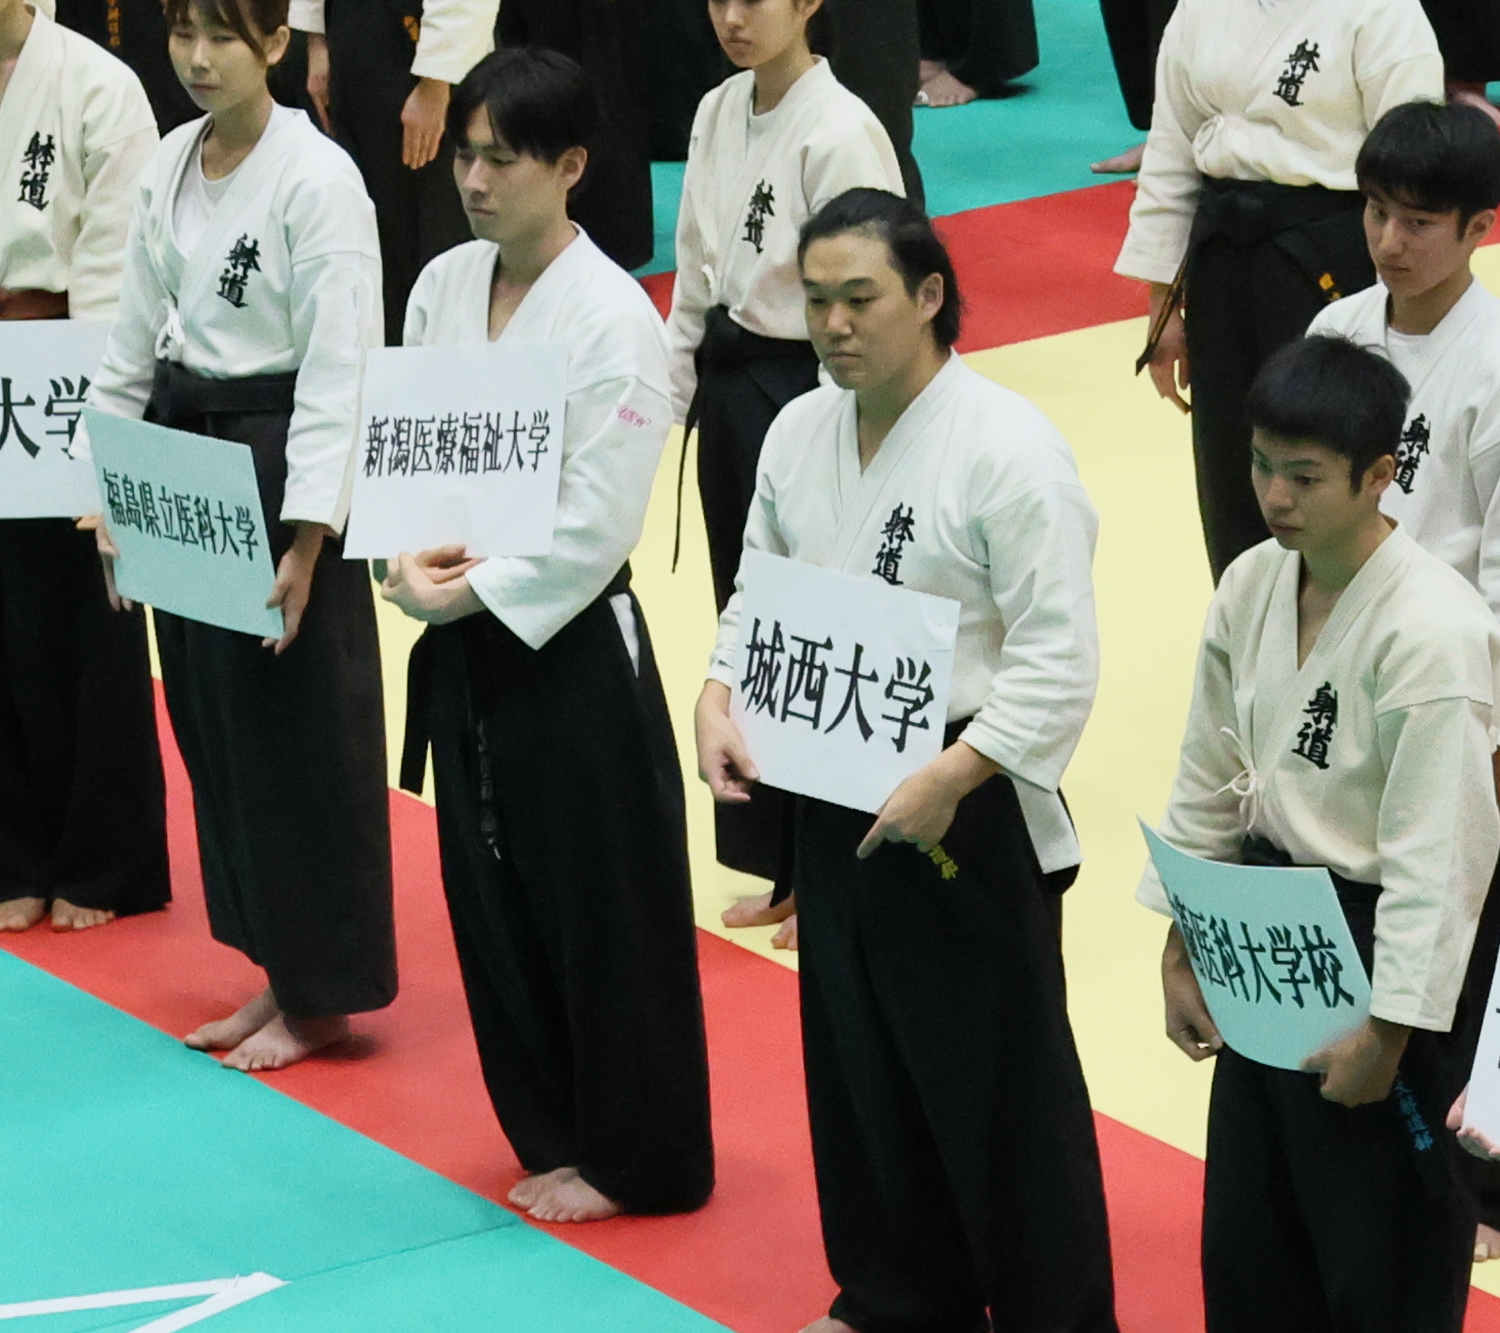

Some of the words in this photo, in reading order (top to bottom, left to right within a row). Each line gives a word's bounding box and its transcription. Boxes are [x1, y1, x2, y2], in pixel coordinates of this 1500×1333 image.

[364, 409, 551, 478] 新潟医療福祉大学
[102, 469, 261, 561] 福島県立医科大学
[740, 617, 935, 754] 城西大学
